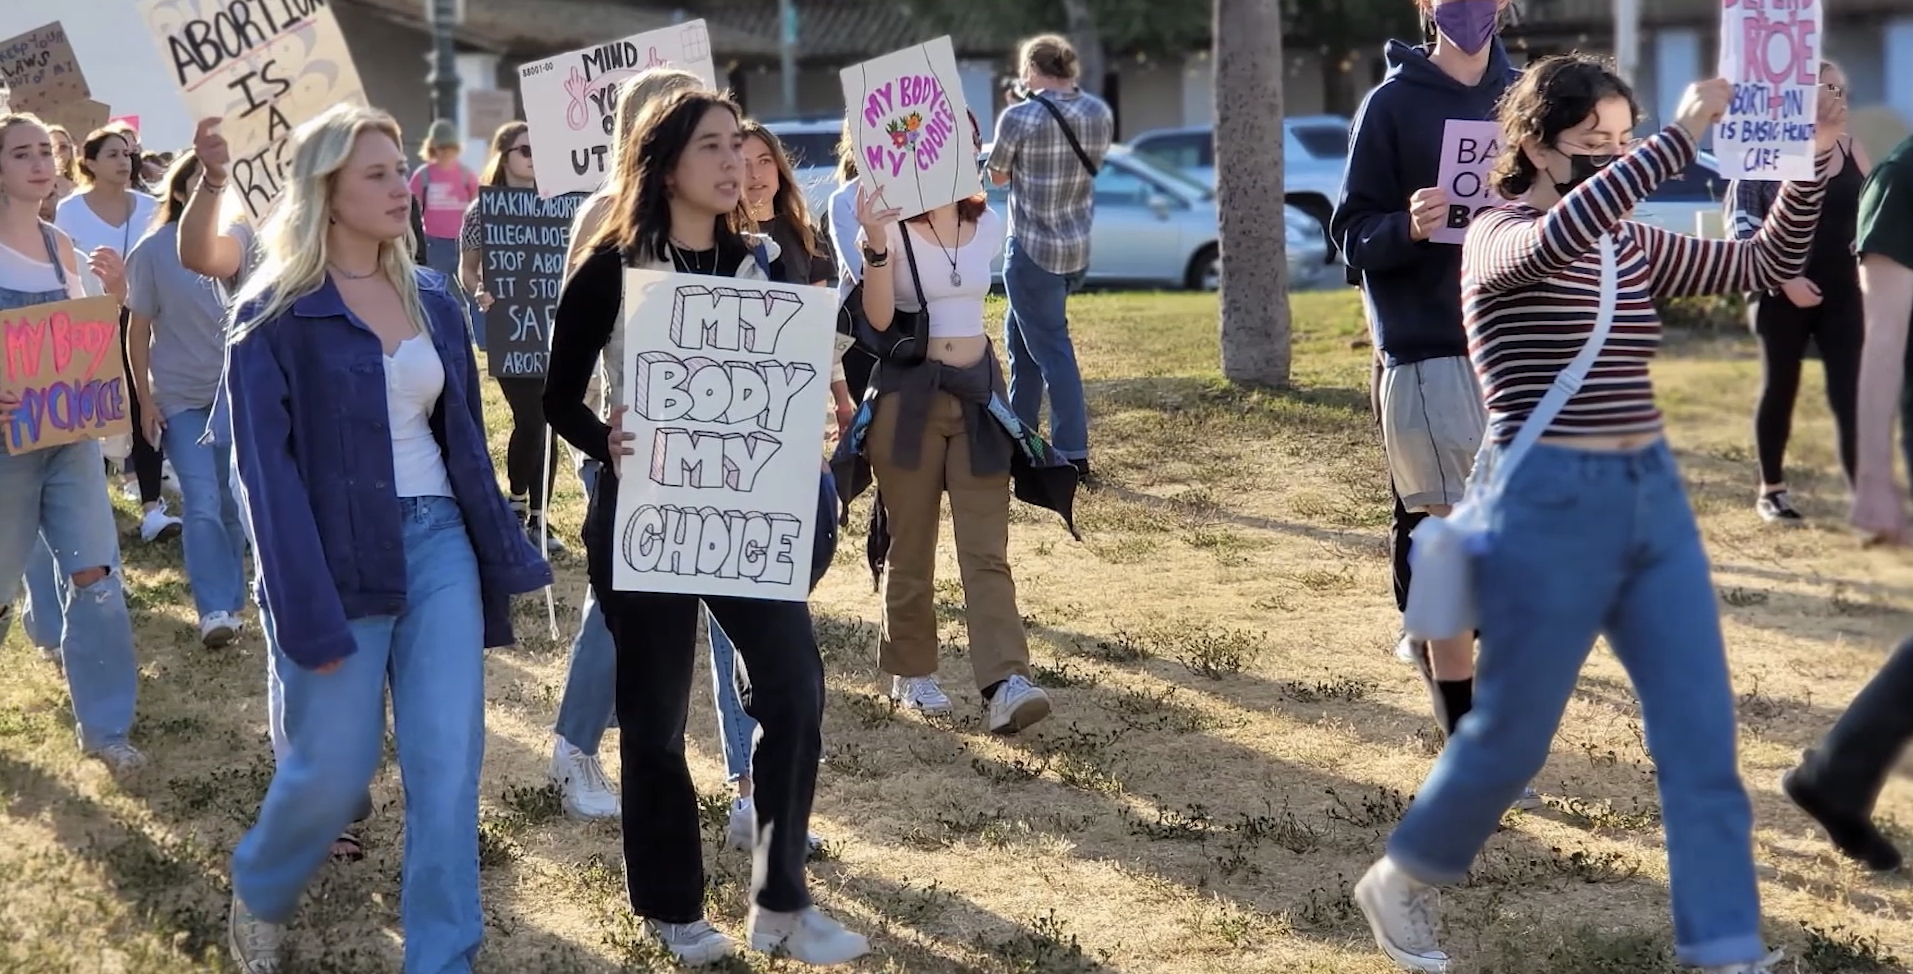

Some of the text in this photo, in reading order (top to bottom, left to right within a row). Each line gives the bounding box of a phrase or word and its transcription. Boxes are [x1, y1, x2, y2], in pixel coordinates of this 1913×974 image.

[2, 51, 50, 77] LAWS
[168, 0, 324, 87] ABORTI
[581, 42, 638, 81] MIND
[1743, 16, 1816, 85] ROE
[228, 59, 290, 118] IS
[590, 83, 619, 116] YO
[864, 75, 943, 128] MY BODY
[268, 105, 291, 141] A
[867, 100, 954, 178] MY CHOICE
[1720, 121, 1736, 140] IS
[1741, 120, 1780, 143] BASIC
[1744, 147, 1781, 172] CARE
[482, 191, 541, 217] MAKING
[485, 223, 539, 245] ILLEGAL
[488, 251, 526, 271] STOP
[495, 277, 516, 299] IT
[669, 285, 803, 354] MY
[4, 312, 116, 383] MY BODY
[48, 377, 125, 432] CHOICE
[635, 351, 816, 432] BODY
[650, 427, 782, 492] MY
[623, 504, 802, 585] CHOICE
